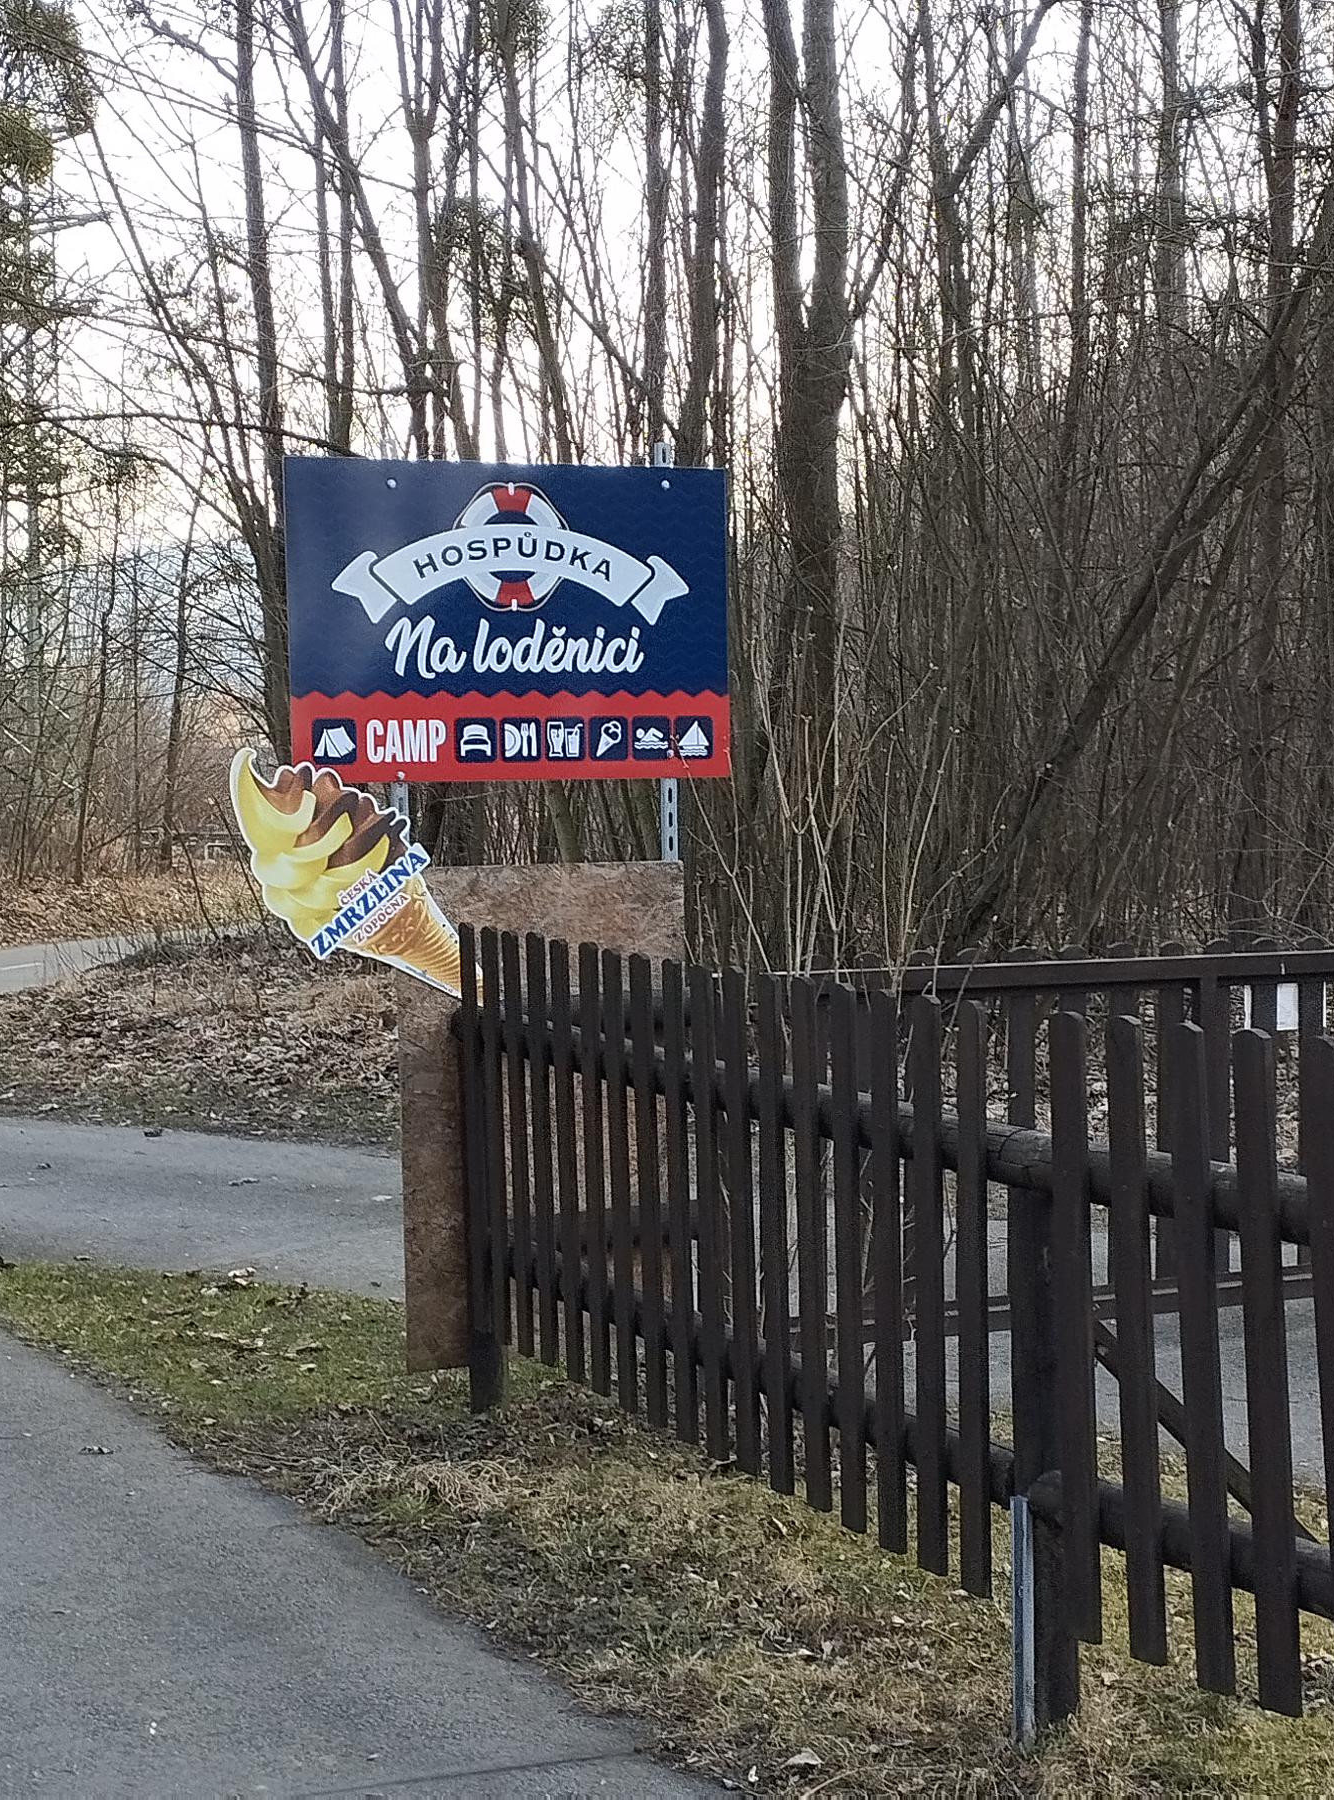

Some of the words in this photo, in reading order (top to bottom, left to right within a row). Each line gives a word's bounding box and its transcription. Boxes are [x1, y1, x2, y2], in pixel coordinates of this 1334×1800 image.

[412, 531, 612, 582] HOSPŮDKA
[385, 615, 467, 679] Na
[472, 617, 645, 674] loděnici
[366, 718, 447, 764] CAMP
[310, 850, 428, 957] ZMRZLINA
[339, 868, 378, 906] ČESKÁ
[354, 930, 365, 944] Z
